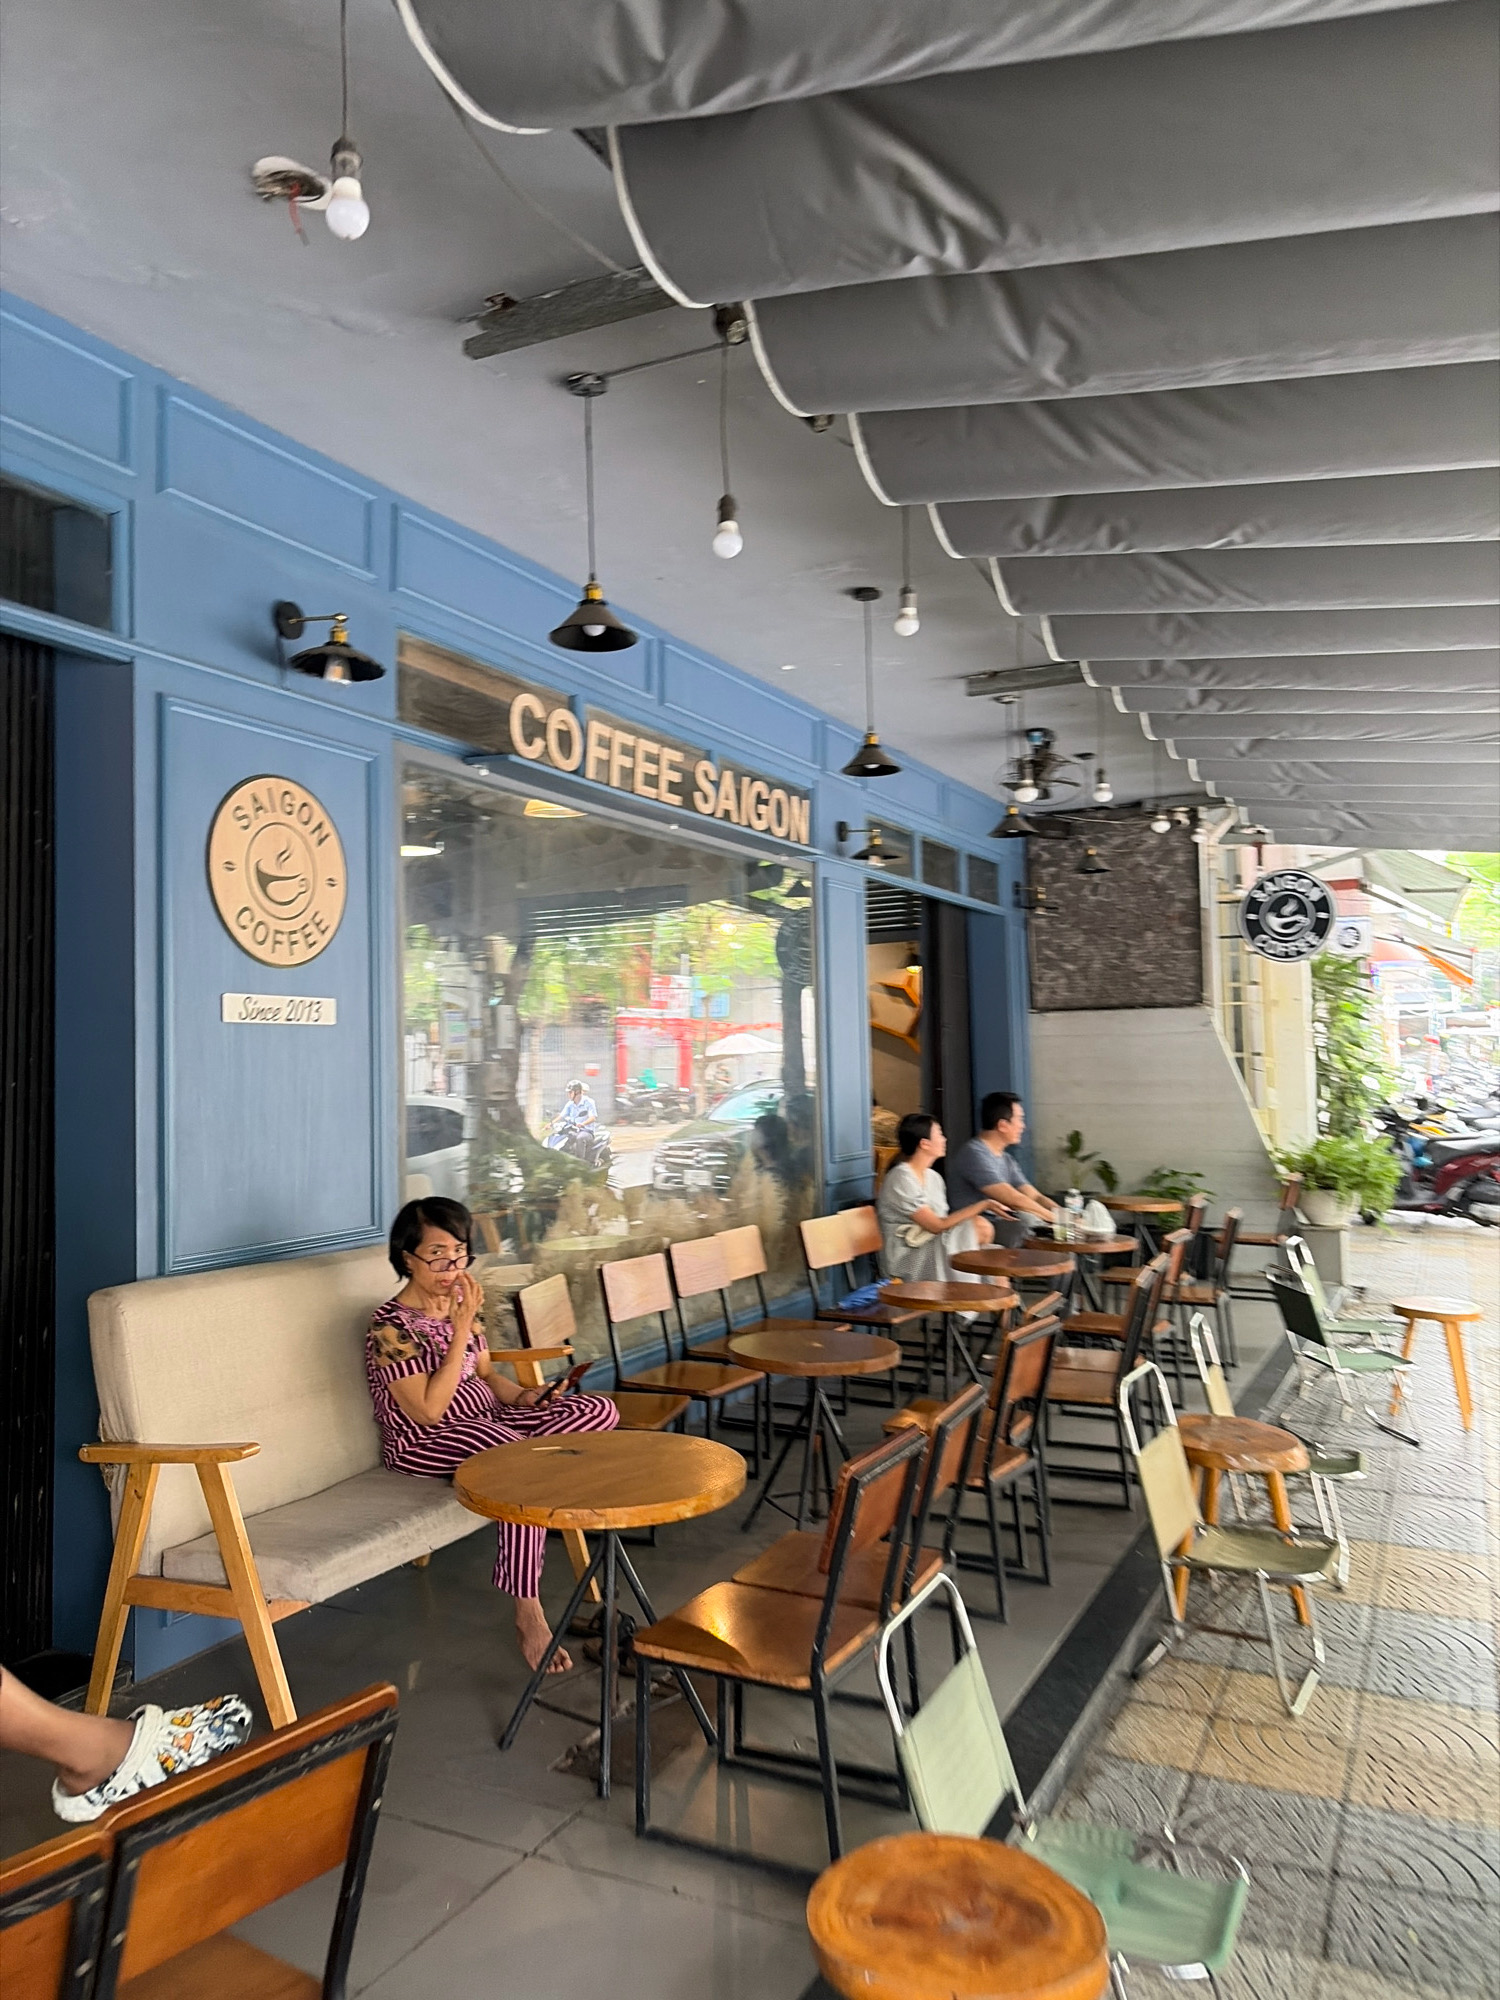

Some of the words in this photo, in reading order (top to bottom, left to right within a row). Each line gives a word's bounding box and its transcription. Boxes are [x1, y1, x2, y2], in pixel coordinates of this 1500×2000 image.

[509, 693, 685, 806] COFFEE
[693, 760, 811, 845] SAIGON
[232, 787, 331, 847] SAIGON
[1250, 875, 1325, 902] SAIGON
[234, 905, 330, 956] COFFEE
[1254, 931, 1320, 957] COFFEE
[238, 996, 282, 1022] Since
[286, 999, 322, 1023] 2013
